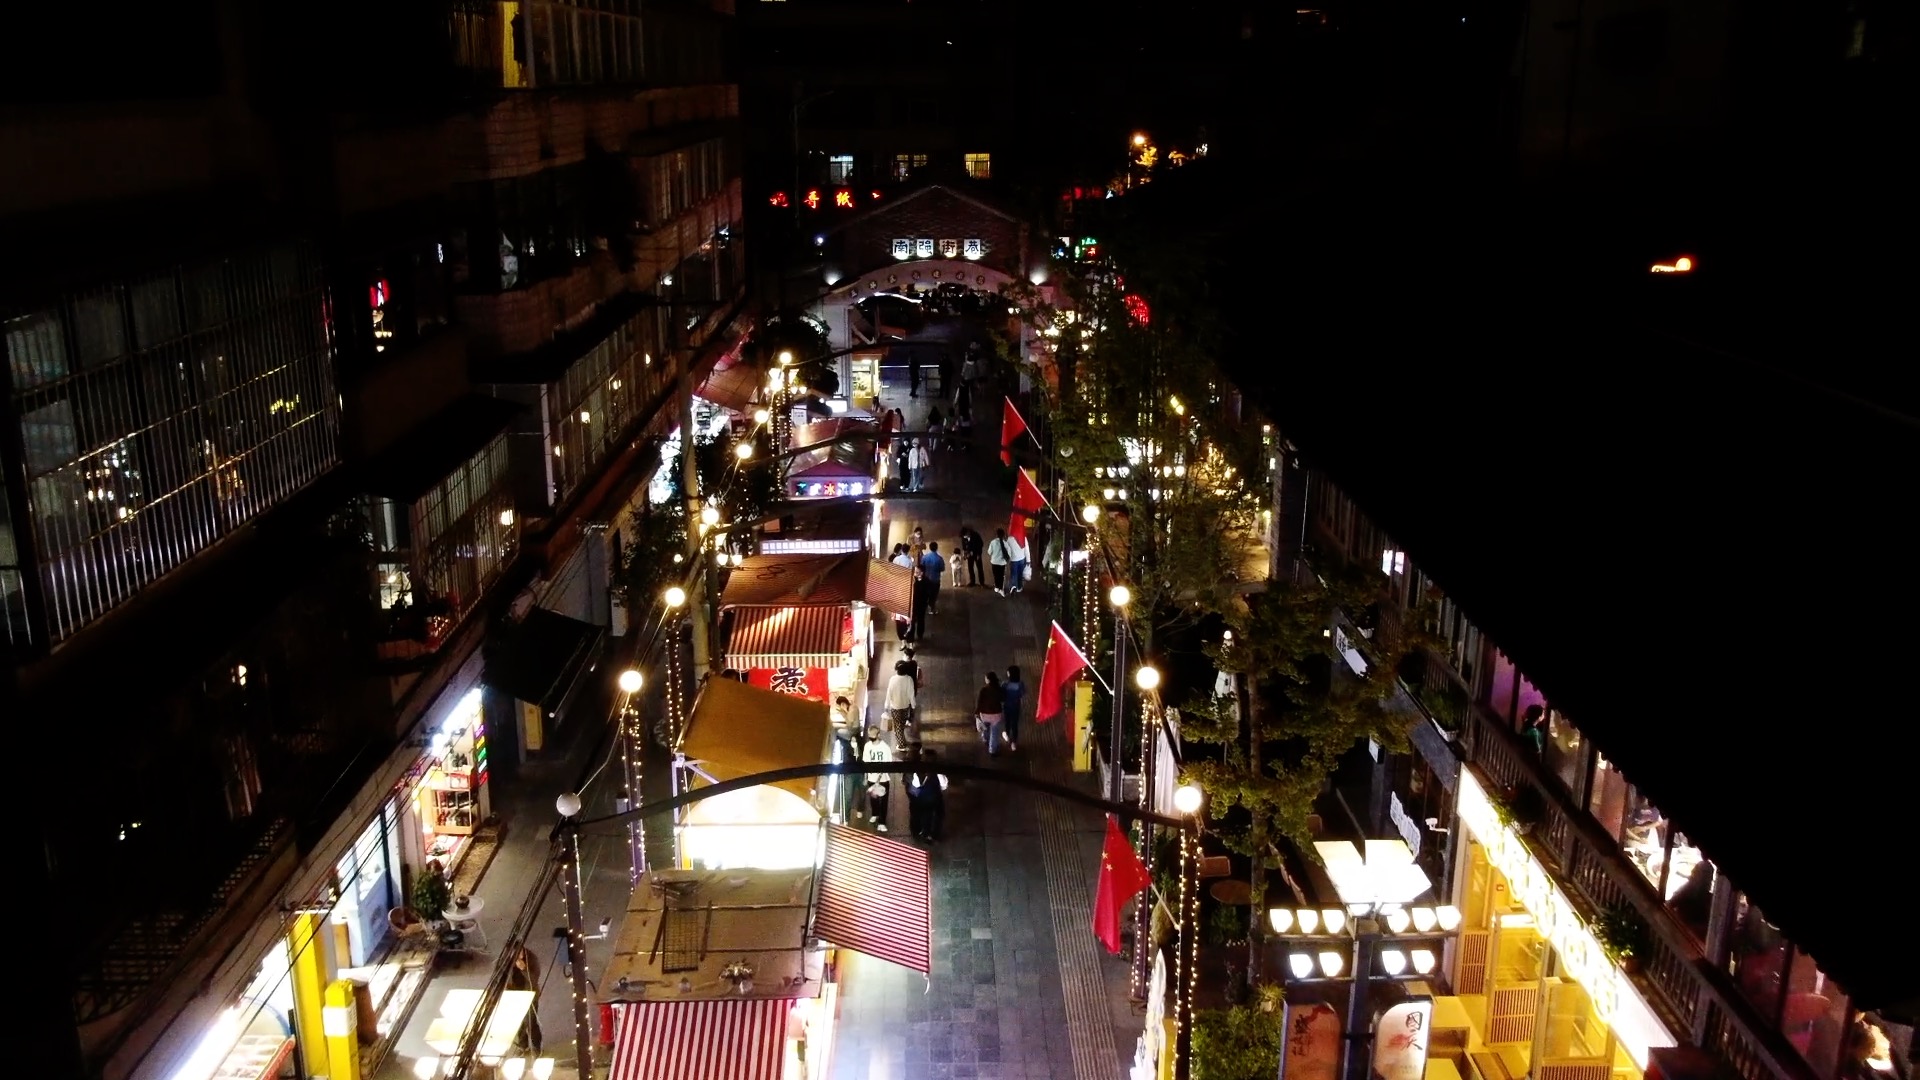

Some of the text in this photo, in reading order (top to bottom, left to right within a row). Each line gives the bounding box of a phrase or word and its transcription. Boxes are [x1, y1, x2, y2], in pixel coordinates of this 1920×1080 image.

[893, 239, 981, 256] 南强街巷
[769, 665, 809, 695] 煮
